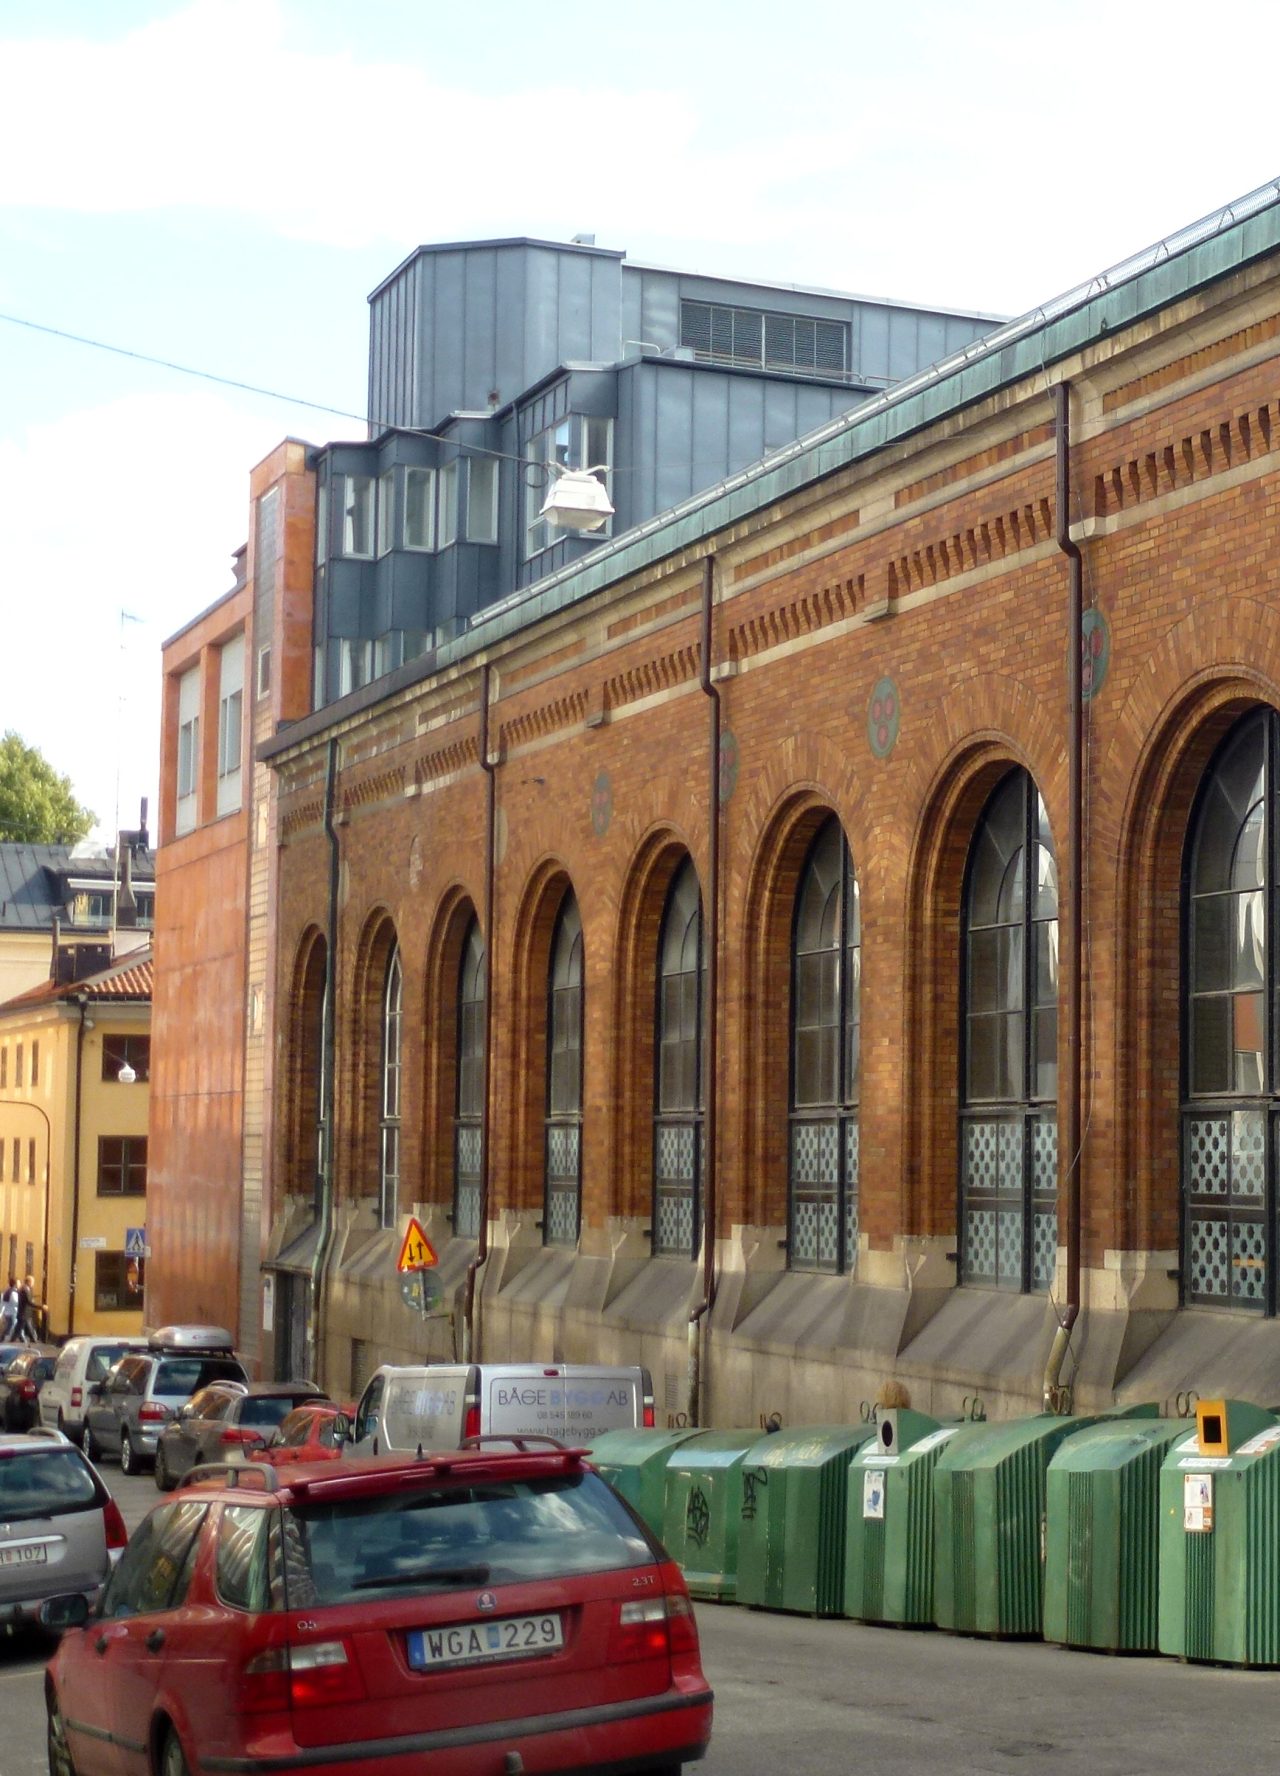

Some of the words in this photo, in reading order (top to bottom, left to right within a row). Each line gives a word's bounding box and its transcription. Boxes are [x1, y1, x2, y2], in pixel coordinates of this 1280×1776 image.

[498, 1387, 546, 1406] BÅGE
[606, 1389, 628, 1406] AB
[427, 1628, 483, 1659] WGA
[504, 1618, 556, 1649] 229
